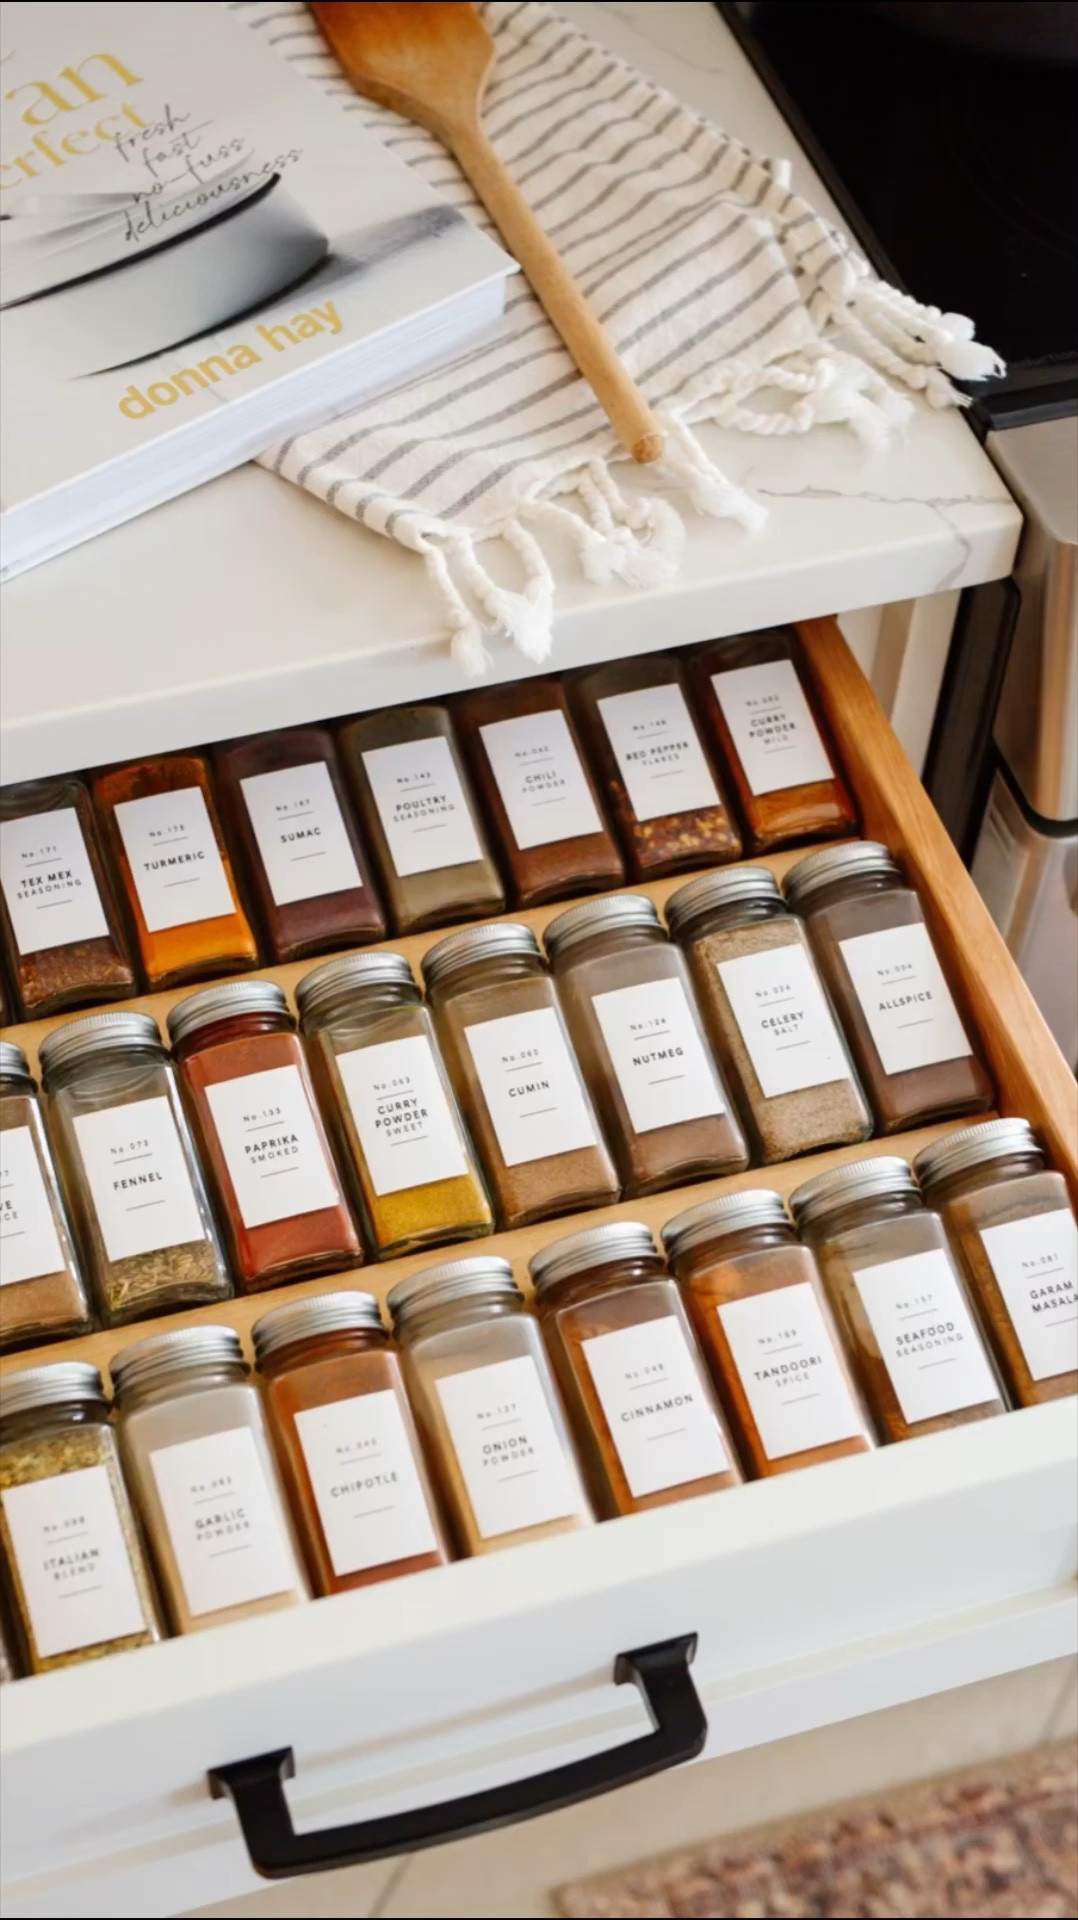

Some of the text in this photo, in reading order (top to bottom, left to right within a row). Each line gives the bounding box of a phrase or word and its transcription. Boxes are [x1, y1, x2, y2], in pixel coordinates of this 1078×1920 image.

[114, 103, 190, 162] fresh
[142, 120, 214, 178] fast
[132, 137, 246, 204] no-fuss
[123, 149, 302, 242] deliciousness
[119, 301, 343, 420] donna hay
[749, 722, 796, 737] POWDER
[751, 714, 785, 727] CURRY
[626, 741, 688, 761] RED PEPPER
[522, 779, 565, 793] POWDER
[525, 770, 556, 784] CHILI
[393, 804, 455, 822] SEASONING
[396, 795, 448, 812] POULTRY
[281, 827, 320, 843] SUMAC
[144, 851, 204, 870] TURMERIC
[21, 870, 72, 888] TEX MEX
[17, 879, 81, 899] SEASONING
[879, 991, 932, 1011] ALLSPICE
[761, 1012, 803, 1028] CELERY
[774, 1024, 798, 1036] SALT
[633, 1047, 683, 1065] NUTMEG
[509, 1081, 549, 1097] CUMIN
[378, 1098, 417, 1115] CURRY
[375, 1109, 428, 1128] POWDER
[386, 1122, 422, 1137] SWEET
[245, 1134, 298, 1154] PAPRIKA
[250, 1146, 298, 1164] SMOKED
[113, 1172, 162, 1190] FENNEL
[1030, 1281, 1073, 1299] GARAM
[1032, 1294, 1078, 1313] MASALA
[896, 1322, 954, 1345] SEAFOOD
[896, 1333, 963, 1357] SEASONING
[754, 1356, 821, 1380] TANDOORI
[775, 1372, 810, 1387] SPICE
[621, 1394, 693, 1422] CINNAMON
[483, 1436, 527, 1454] ONION
[483, 1447, 534, 1466] POWDER
[330, 1472, 397, 1497] CHIPOTLE
[195, 1508, 245, 1530] GARLIC
[196, 1521, 250, 1541] POWDER
[44, 1549, 99, 1570] ITALIAN
